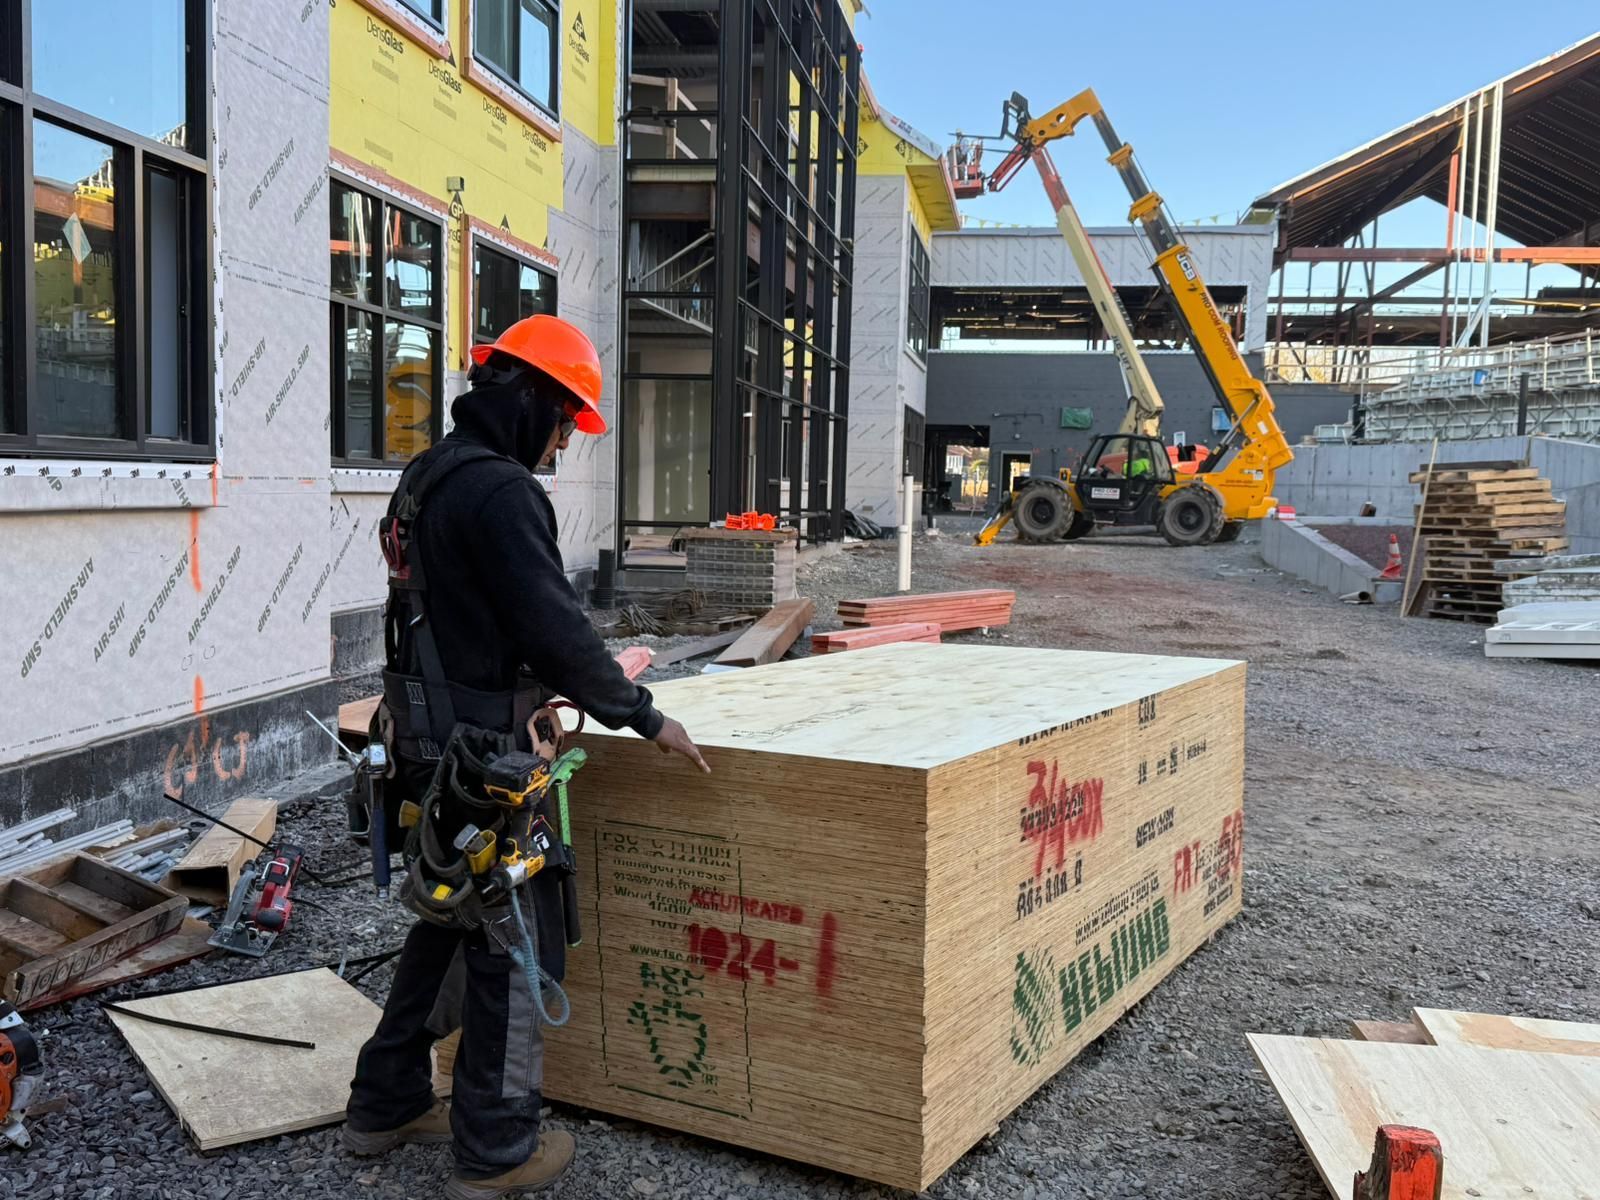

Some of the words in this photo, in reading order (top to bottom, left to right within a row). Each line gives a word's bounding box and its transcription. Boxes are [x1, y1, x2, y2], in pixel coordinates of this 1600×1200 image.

[429, 59, 462, 94] DensGlass
[522, 125, 547, 152] DensGlass
[263, 137, 294, 189] AIR-SHIELD
[248, 184, 262, 211] SMP
[294, 175, 322, 226] AIR-SHIELD
[451, 201, 463, 219] GP
[1176, 253, 1197, 281] JCB
[1201, 292, 1211, 309] PRO
[1208, 308, 1221, 326] COM
[1217, 327, 1237, 360] ROOFING
[231, 336, 266, 397] AIR-SHIELD
[265, 367, 297, 427] AIR-SHIELD
[297, 343, 310, 370] SMP
[3, 465, 16, 477] 3M
[38, 466, 50, 478] 3M
[70, 466, 82, 478] 3M
[101, 467, 113, 478] 3M
[129, 468, 140, 479] 3M
[157, 469, 167, 480] 3M
[182, 470, 192, 480] 3M
[148, 549, 189, 624] AIR-SHIELD
[273, 541, 303, 604] AIR-SHIELD
[44, 557, 95, 640] AIR-SHIELD
[188, 574, 226, 645] AIR-SHIELD
[226, 545, 241, 575] SMP
[301, 563, 331, 624] AIR-SHIELD
[93, 601, 125, 662] AIR-SHI
[257, 604, 271, 633] SMP
[128, 624, 147, 658] SMP
[21, 640, 42, 678] SMP
